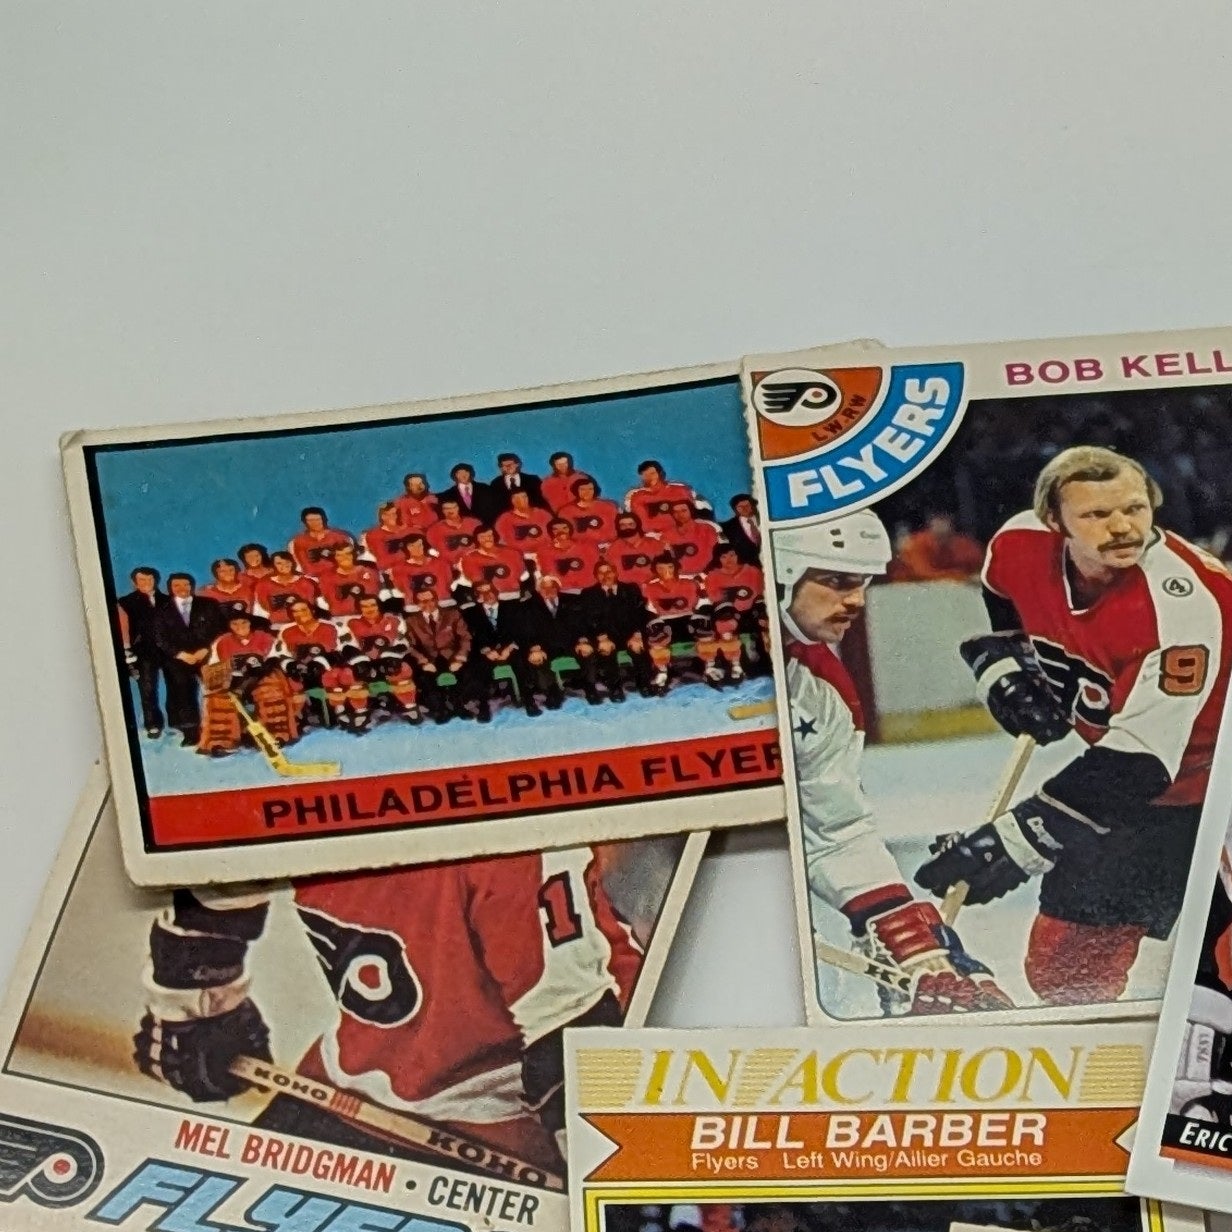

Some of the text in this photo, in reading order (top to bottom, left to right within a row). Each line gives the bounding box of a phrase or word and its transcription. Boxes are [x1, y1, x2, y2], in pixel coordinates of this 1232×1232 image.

[1005, 357, 1103, 387] BOB
[787, 375, 951, 508] FLYERS
[1159, 644, 1210, 697] 9
[263, 762, 623, 828] PHILADELPHIA
[639, 1045, 1084, 1106] IN ACTION
[253, 1067, 548, 1185] KOHO KOHO
[690, 1112, 1047, 1151] BILL BARBER
[174, 1119, 540, 1227] MEL BRIDGMAN CENTER
[691, 1153, 760, 1175] Flyers
[782, 1150, 825, 1170] Left
[957, 1148, 1043, 1168] Gauche
